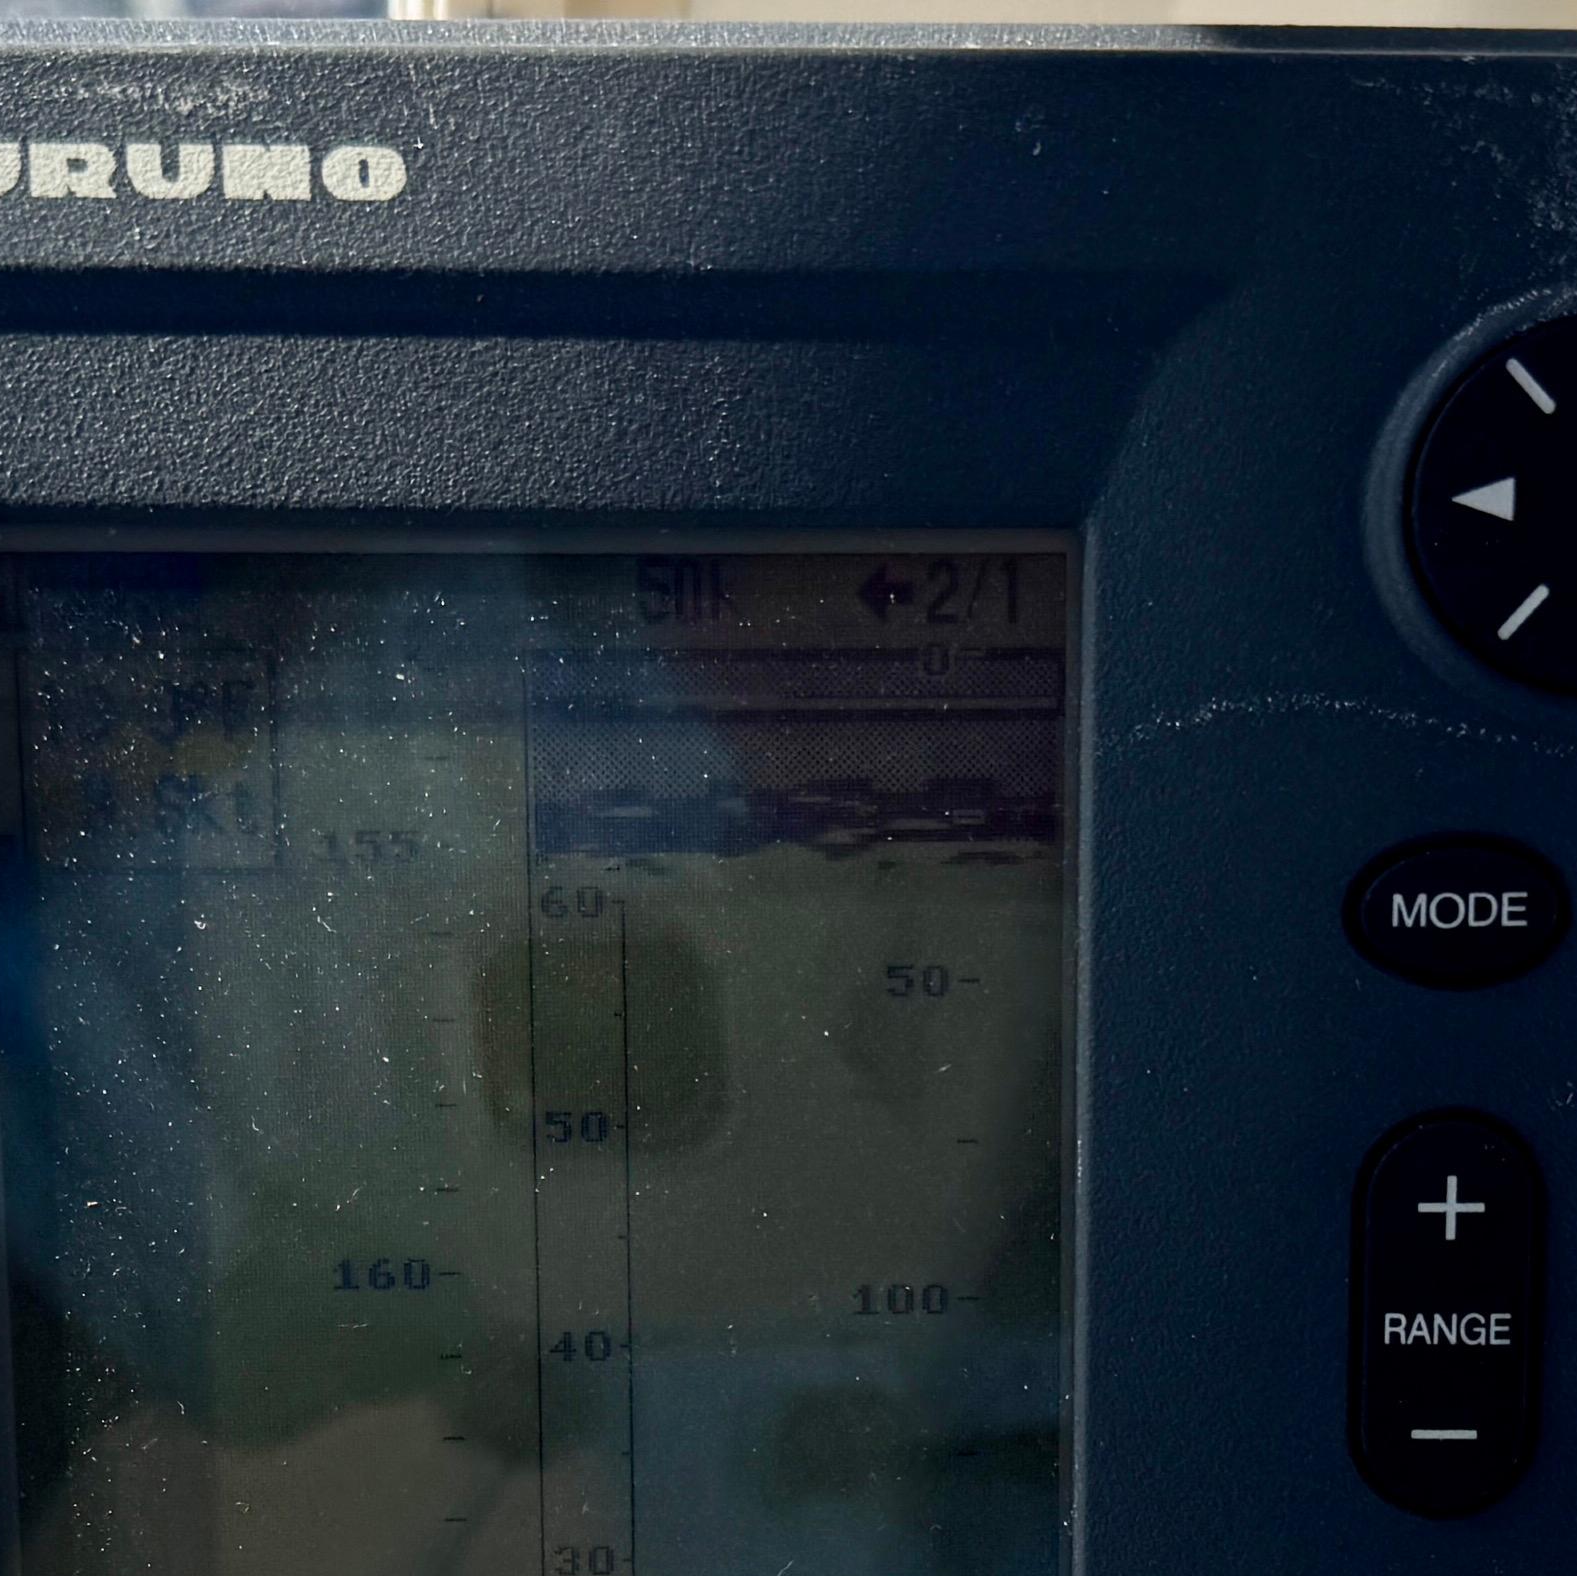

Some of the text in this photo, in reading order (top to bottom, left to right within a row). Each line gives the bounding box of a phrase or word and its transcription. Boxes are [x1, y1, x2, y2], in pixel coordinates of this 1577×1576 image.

[541, 886, 604, 919] 60
[1390, 890, 1529, 929] MODE
[886, 965, 950, 998] 50
[544, 1111, 610, 1144] 50
[332, 1258, 432, 1291] 160
[852, 1284, 950, 1317] 100
[1383, 1312, 1512, 1346] RANGE
[549, 1330, 613, 1363] 40
[553, 1545, 616, 1576] 30
